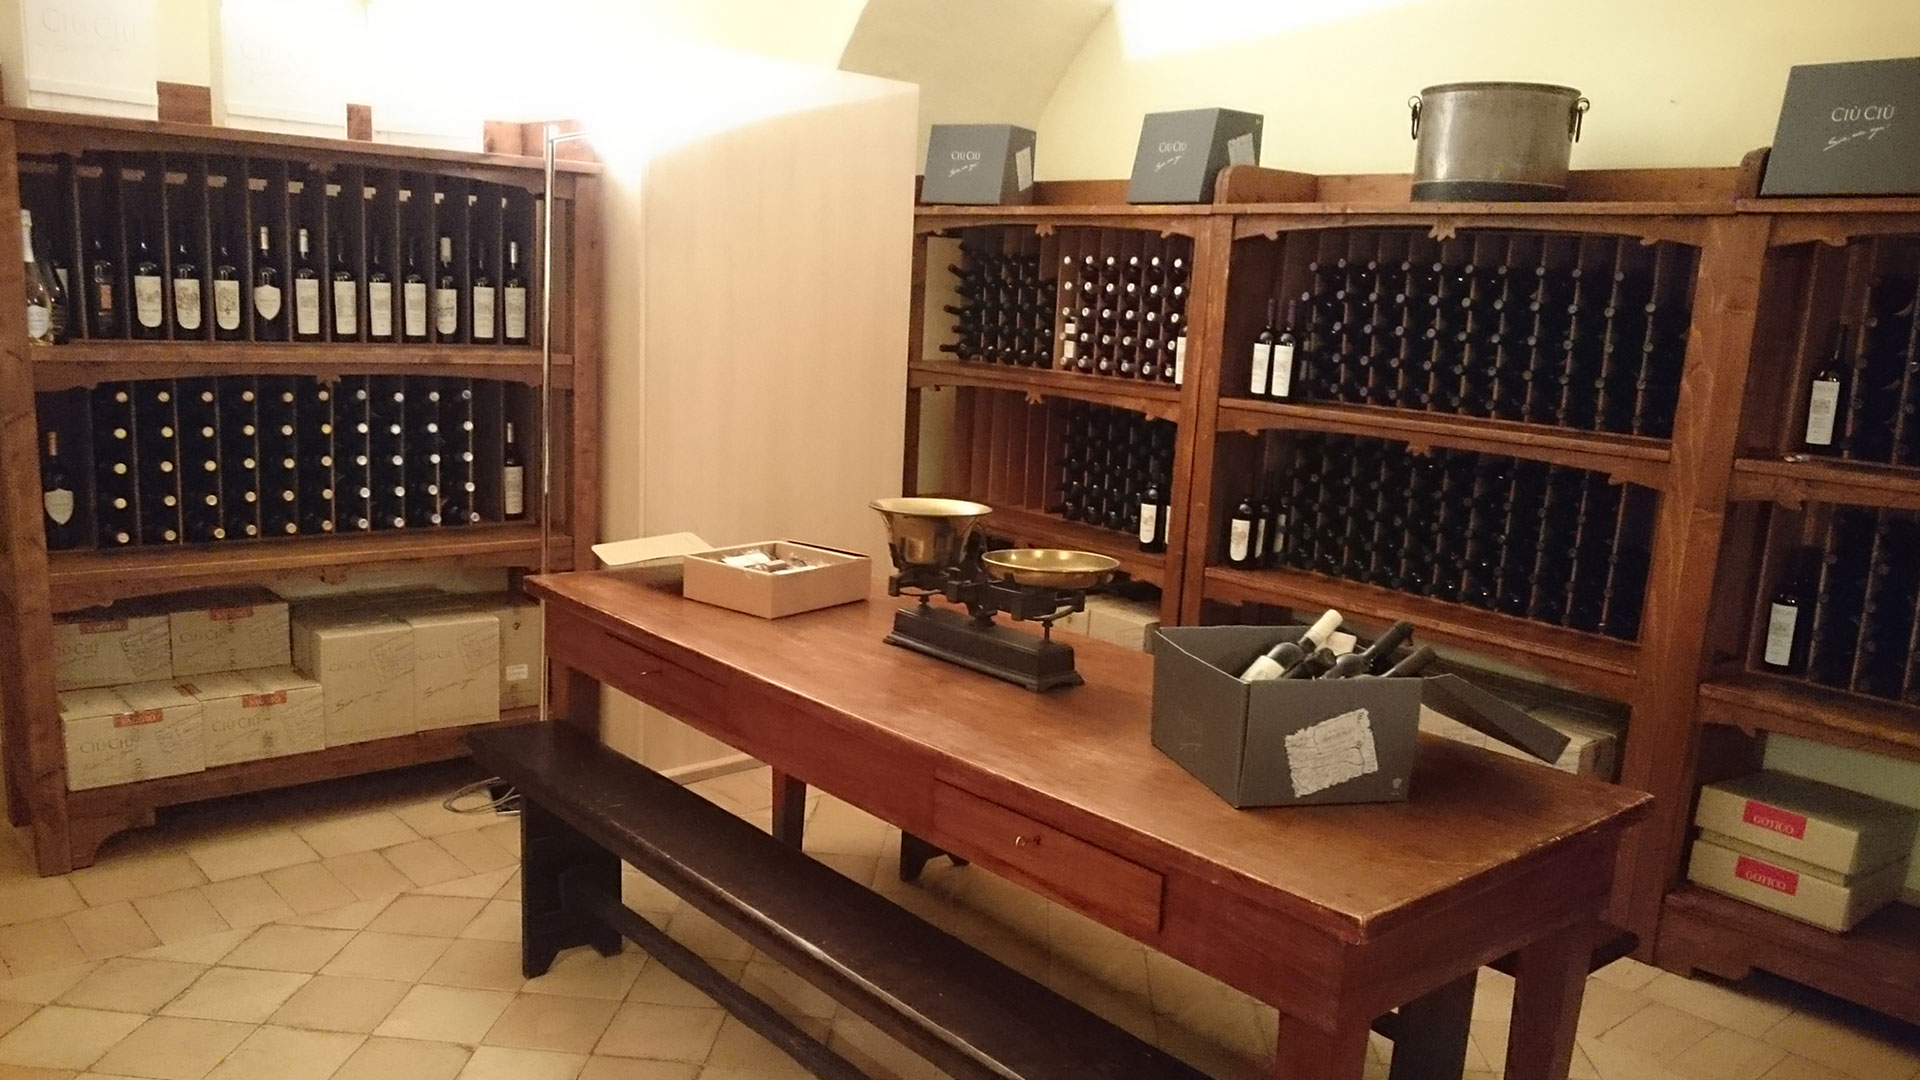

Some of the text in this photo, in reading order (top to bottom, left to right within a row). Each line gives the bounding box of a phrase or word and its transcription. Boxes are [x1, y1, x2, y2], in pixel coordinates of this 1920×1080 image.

[1831, 104, 1895, 122] CIÙ CIÙ
[1753, 815, 1794, 834] GOTICO
[1745, 870, 1786, 891] GOTICO
